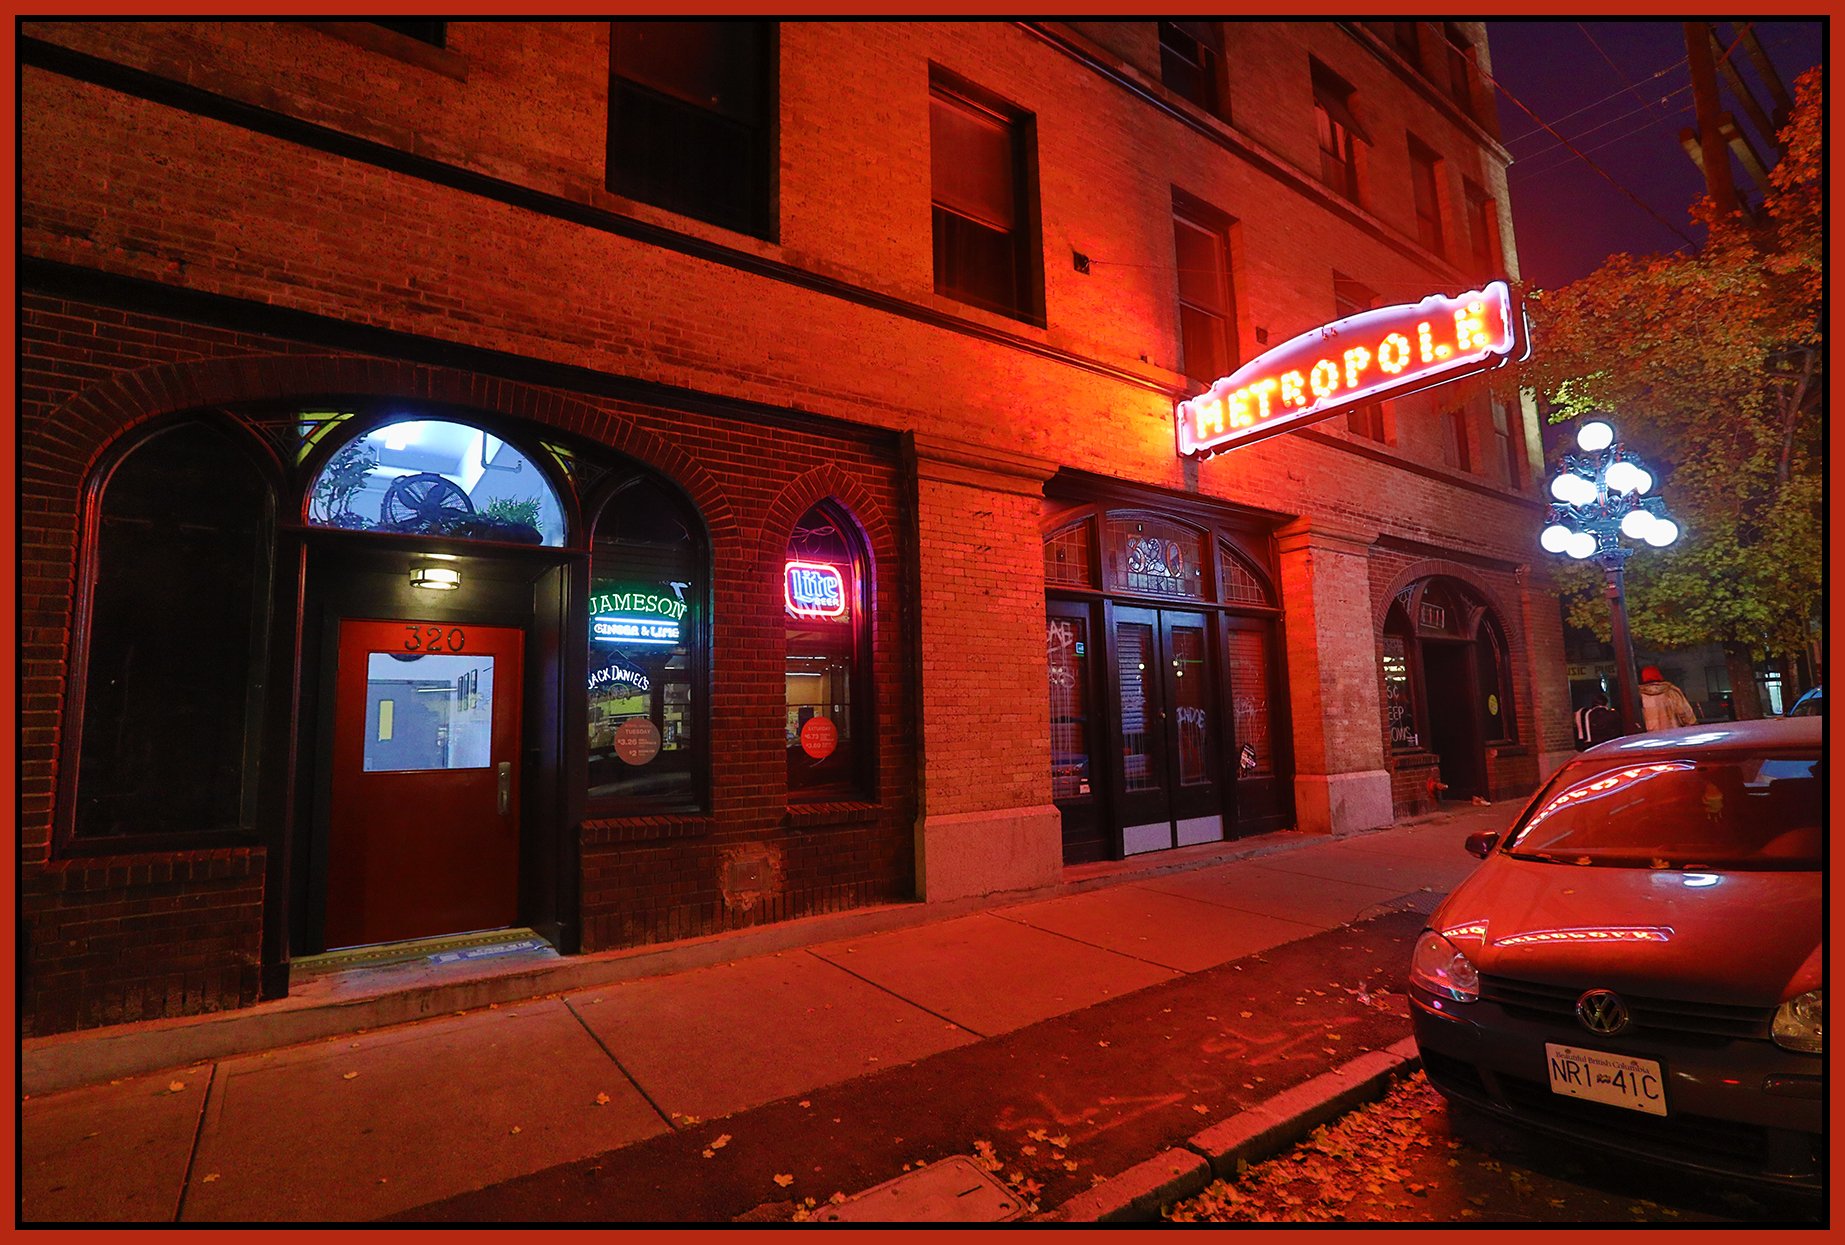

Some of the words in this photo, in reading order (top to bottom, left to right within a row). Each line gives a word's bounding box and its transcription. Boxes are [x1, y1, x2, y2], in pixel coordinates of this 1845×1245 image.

[1195, 300, 1490, 440] METROPOLE
[1128, 534, 1183, 577] 320
[790, 569, 838, 603] Lite
[590, 593, 687, 620] JAMESON
[815, 598, 840, 607] BEER
[404, 625, 465, 652] 320
[594, 623, 639, 636] GINGER
[641, 626, 650, 636] &
[650, 627, 680, 638] LIME
[588, 667, 611, 690] JACK
[611, 664, 650, 691] DANIEL'S
[1567, 666, 1586, 675] SIC
[1555, 1051, 1587, 1062] Beautiful
[1588, 1056, 1612, 1067] British
[1612, 1061, 1651, 1074] Columbia
[1551, 1057, 1591, 1087] NR1
[1612, 1069, 1659, 1099] 41C
